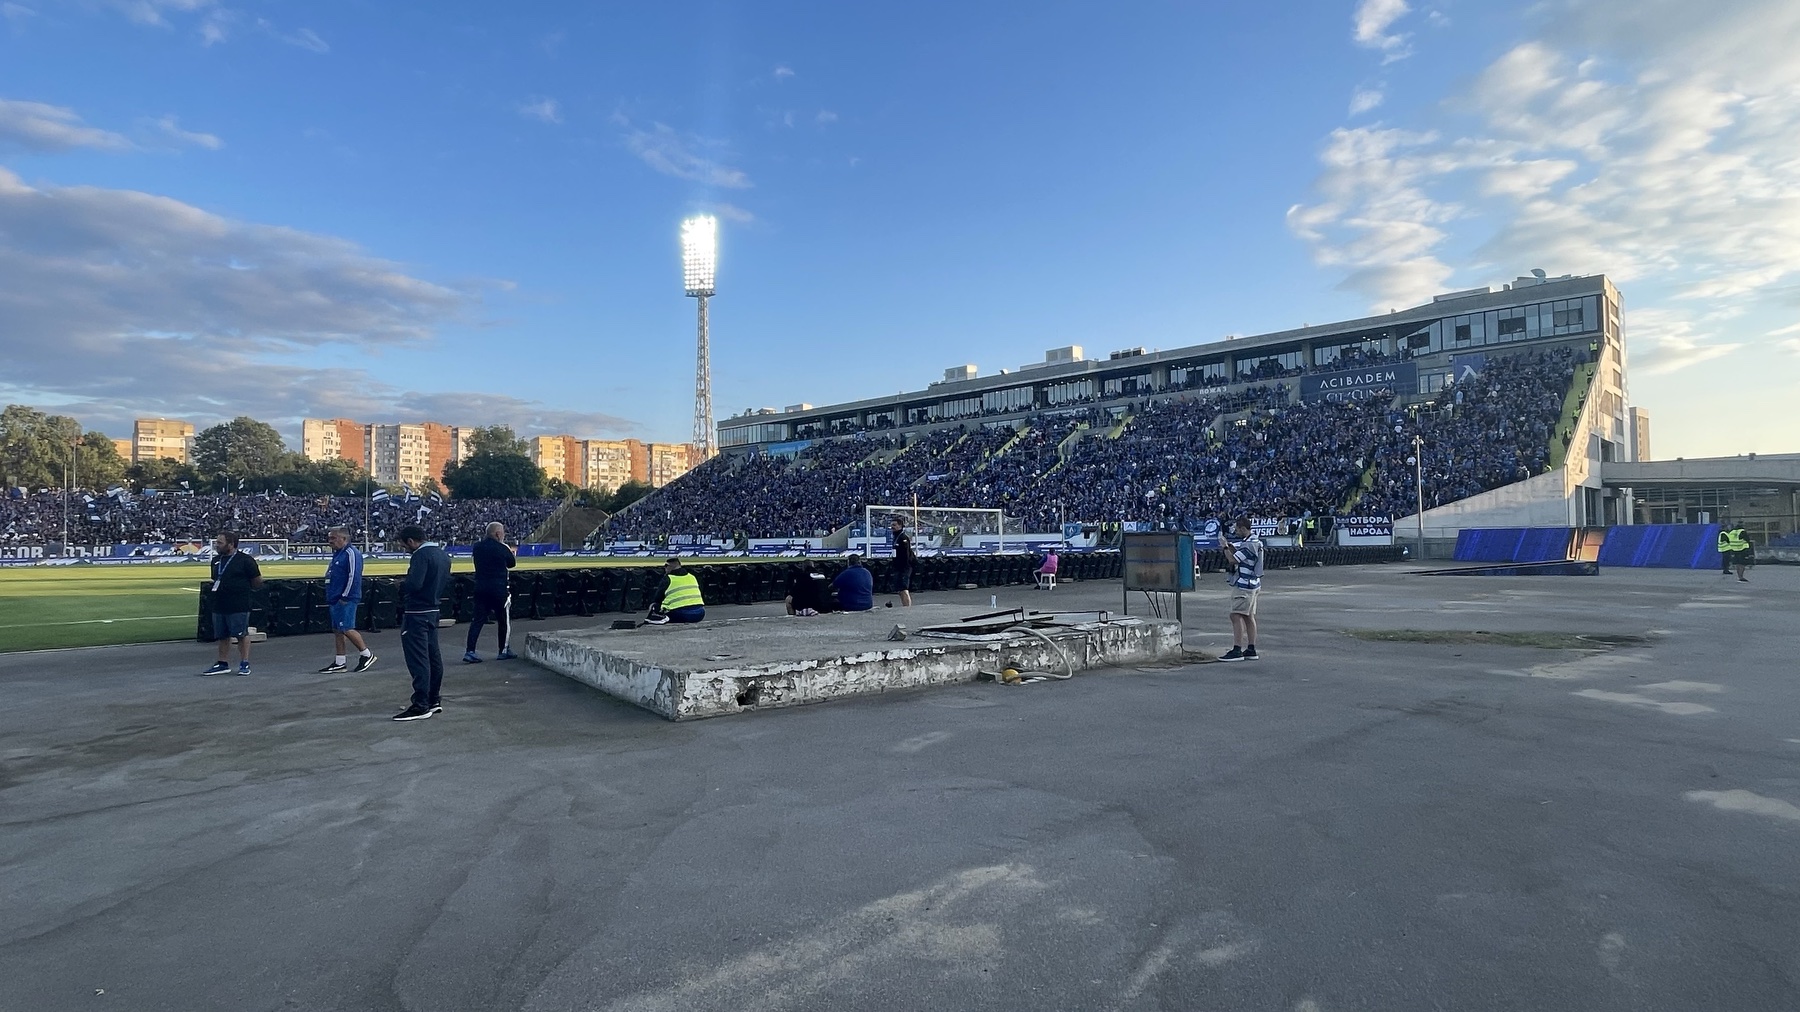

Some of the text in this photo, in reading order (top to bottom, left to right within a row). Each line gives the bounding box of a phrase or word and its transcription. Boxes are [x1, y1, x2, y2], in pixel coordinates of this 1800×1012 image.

[1320, 371, 1396, 389] ACIBADEM
[1350, 516, 1390, 524] ОТБОРА
[1350, 527, 1390, 536] НАРОДА
